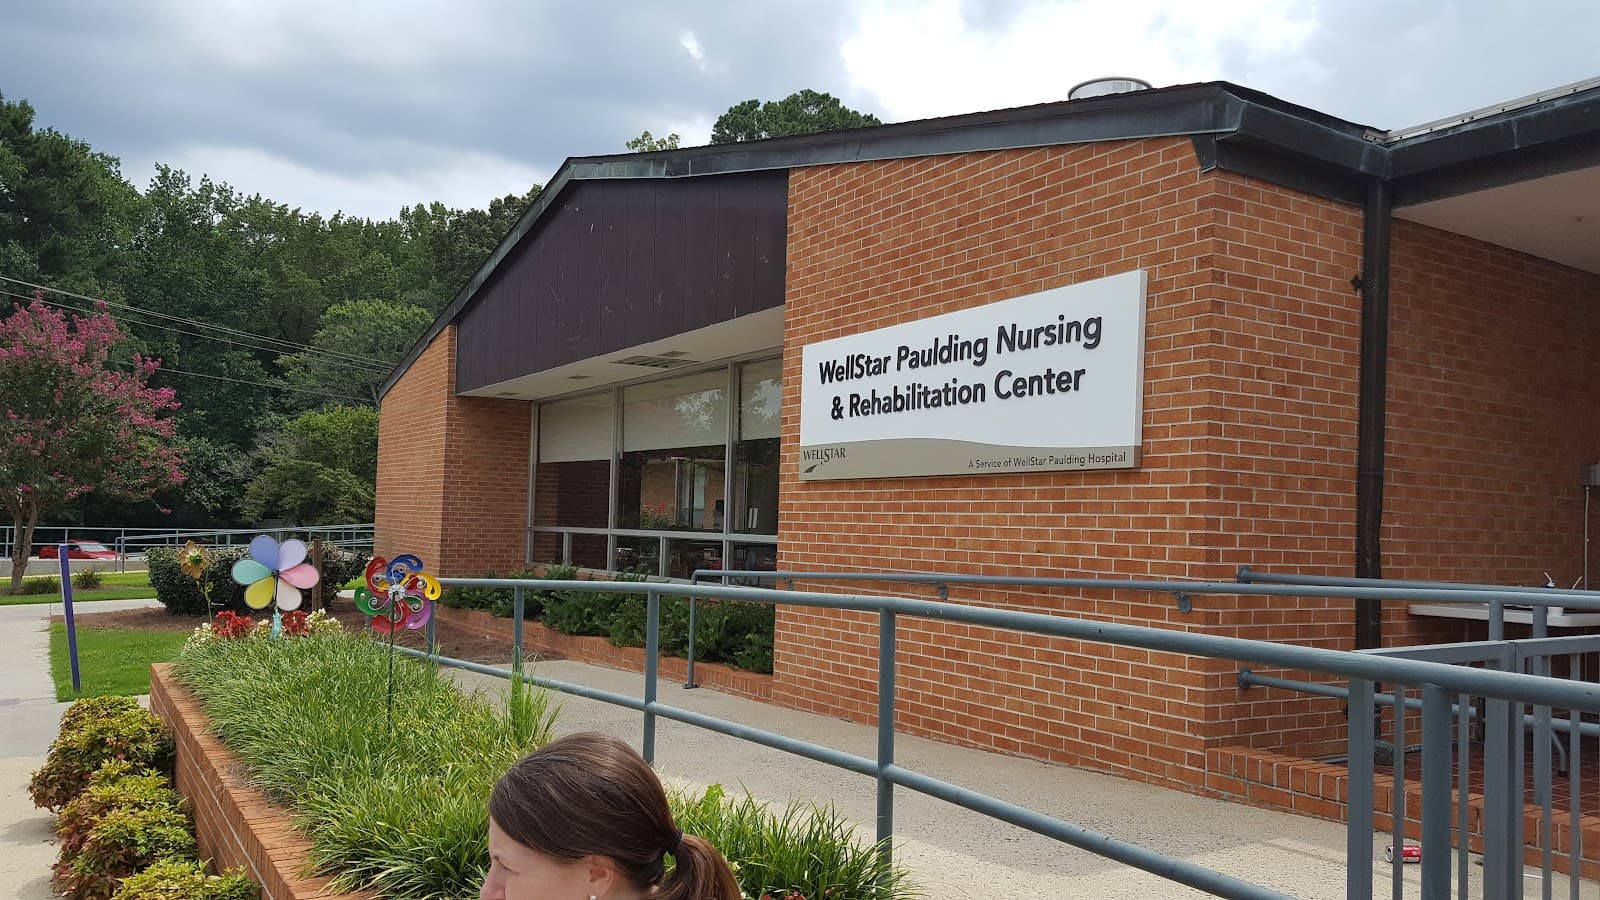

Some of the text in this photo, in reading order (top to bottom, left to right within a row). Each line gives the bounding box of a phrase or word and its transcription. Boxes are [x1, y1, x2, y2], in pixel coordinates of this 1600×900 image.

[819, 315, 1102, 385] WellStar Paulding Nursing
[831, 367, 1086, 420] & Rehabilitation Center
[803, 447, 846, 463] WELLSTAR
[968, 451, 1126, 469] A Service of WellStar Paulding Hospital
